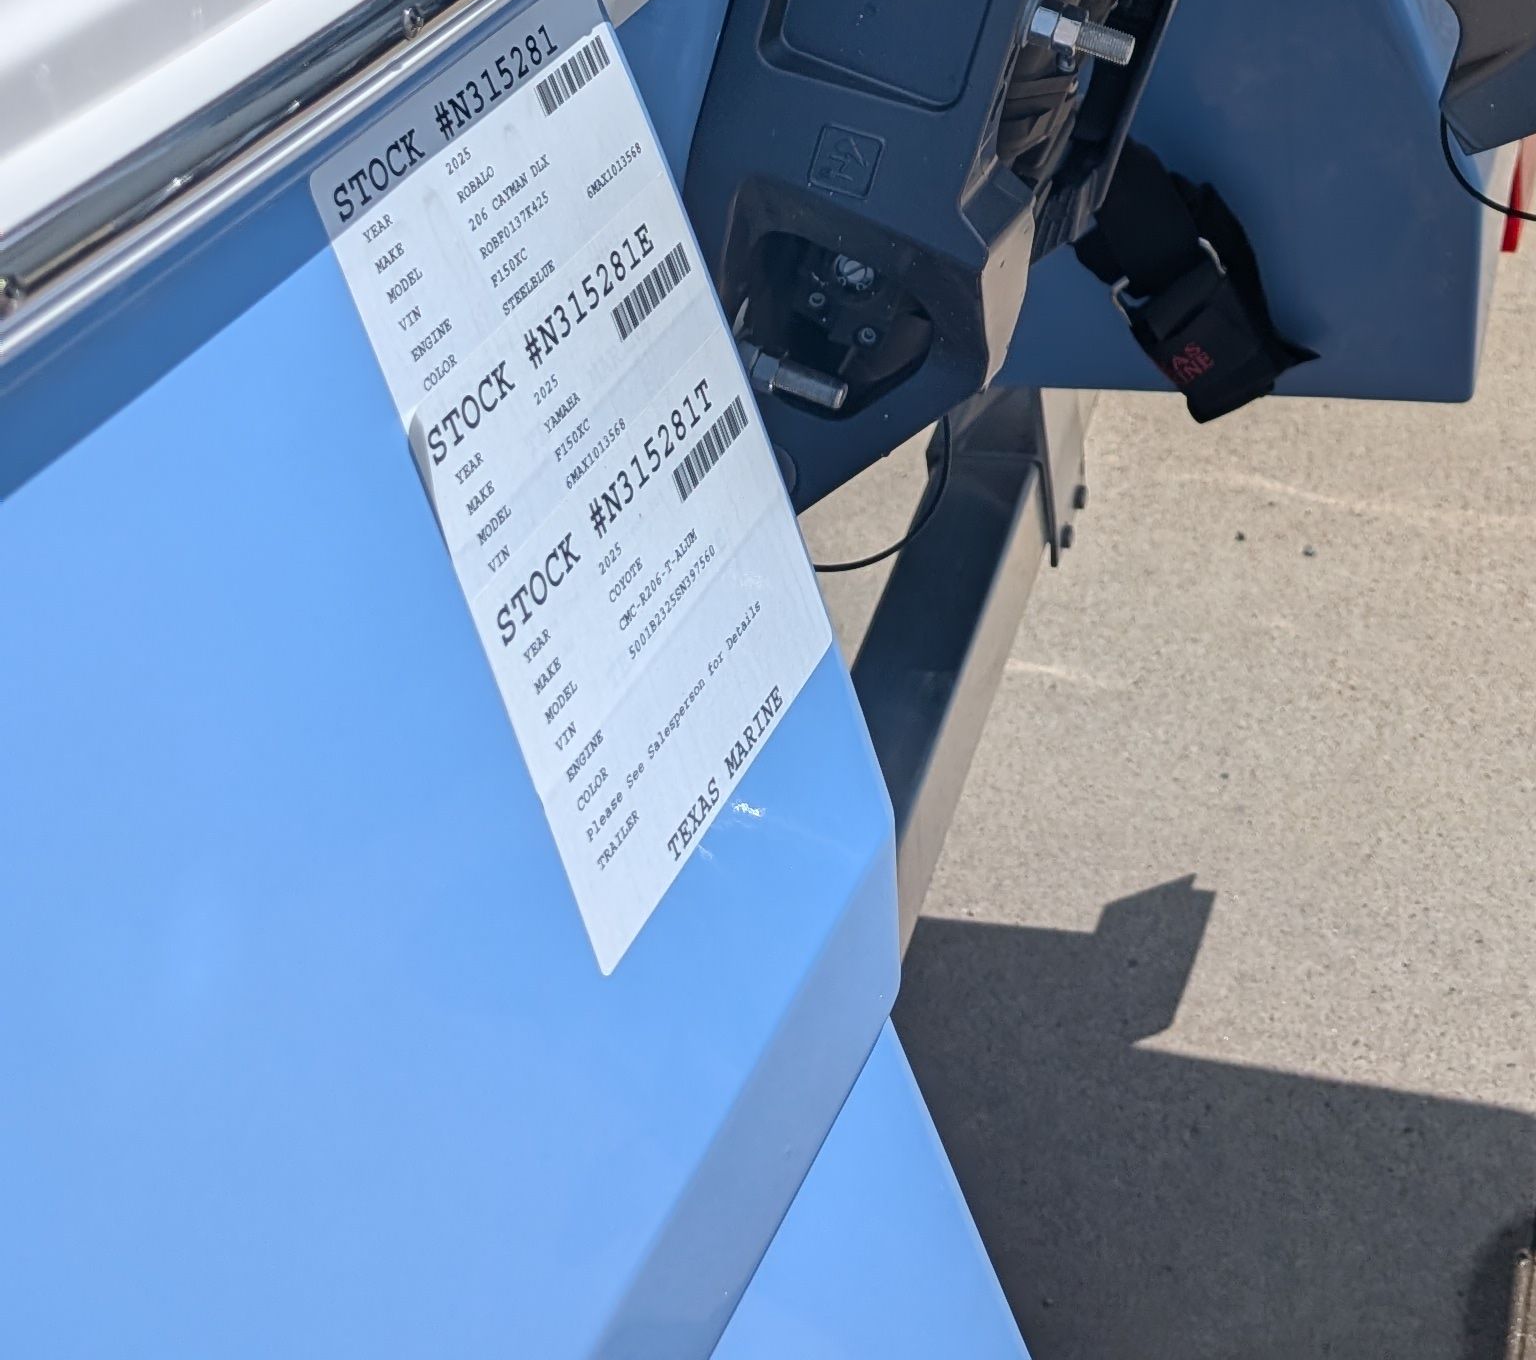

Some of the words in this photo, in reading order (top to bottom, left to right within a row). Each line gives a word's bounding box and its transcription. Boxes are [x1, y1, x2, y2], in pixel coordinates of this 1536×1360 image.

[333, 129, 425, 222] STOCK
[434, 24, 558, 140] #N315281
[362, 214, 393, 245] YEAR
[445, 147, 472, 176] 2025
[374, 242, 405, 274] MAKE
[456, 165, 495, 204] ROBALO
[386, 267, 423, 304] MODEL
[468, 208, 489, 232] 206
[491, 172, 529, 212] CAYMAN
[529, 154, 551, 180] DLX
[410, 318, 453, 362] ENGINE
[490, 247, 529, 288] F150XC
[586, 142, 642, 199] 6MAX1013568
[397, 306, 423, 332] VIN
[422, 353, 458, 392] COLOR
[502, 259, 556, 316] STEELBLUE
[427, 360, 516, 466] STOCK
[524, 223, 655, 370] #N315281E
[454, 452, 484, 485] YEAR
[533, 374, 560, 406] 2025
[466, 481, 496, 516] MAKE
[543, 392, 581, 434] YAMAHA
[476, 505, 513, 546] MODEL
[554, 417, 591, 463] F150XC
[487, 545, 512, 573] VIN
[566, 417, 626, 490] 6MAX1013568
[496, 532, 582, 647] STOCK
[589, 378, 712, 539] #N315281T
[523, 628, 552, 664] YEAR
[598, 541, 623, 576] 2025
[533, 656, 562, 698] MAKE
[608, 556, 644, 604] COYOTE
[543, 680, 579, 724] MODEL
[618, 527, 699, 632] CMC-R206-T-ALUM
[554, 721, 578, 752] VIN
[565, 729, 605, 783] ENGINE
[586, 790, 624, 843] Please
[626, 762, 645, 790] See
[647, 677, 706, 761] Salesperson
[707, 651, 724, 677] for
[725, 600, 762, 651] Details
[667, 776, 721, 862] TEXAS
[723, 685, 784, 780] MARINE
[576, 766, 609, 812] COLOR
[597, 809, 641, 872] TRAILER
